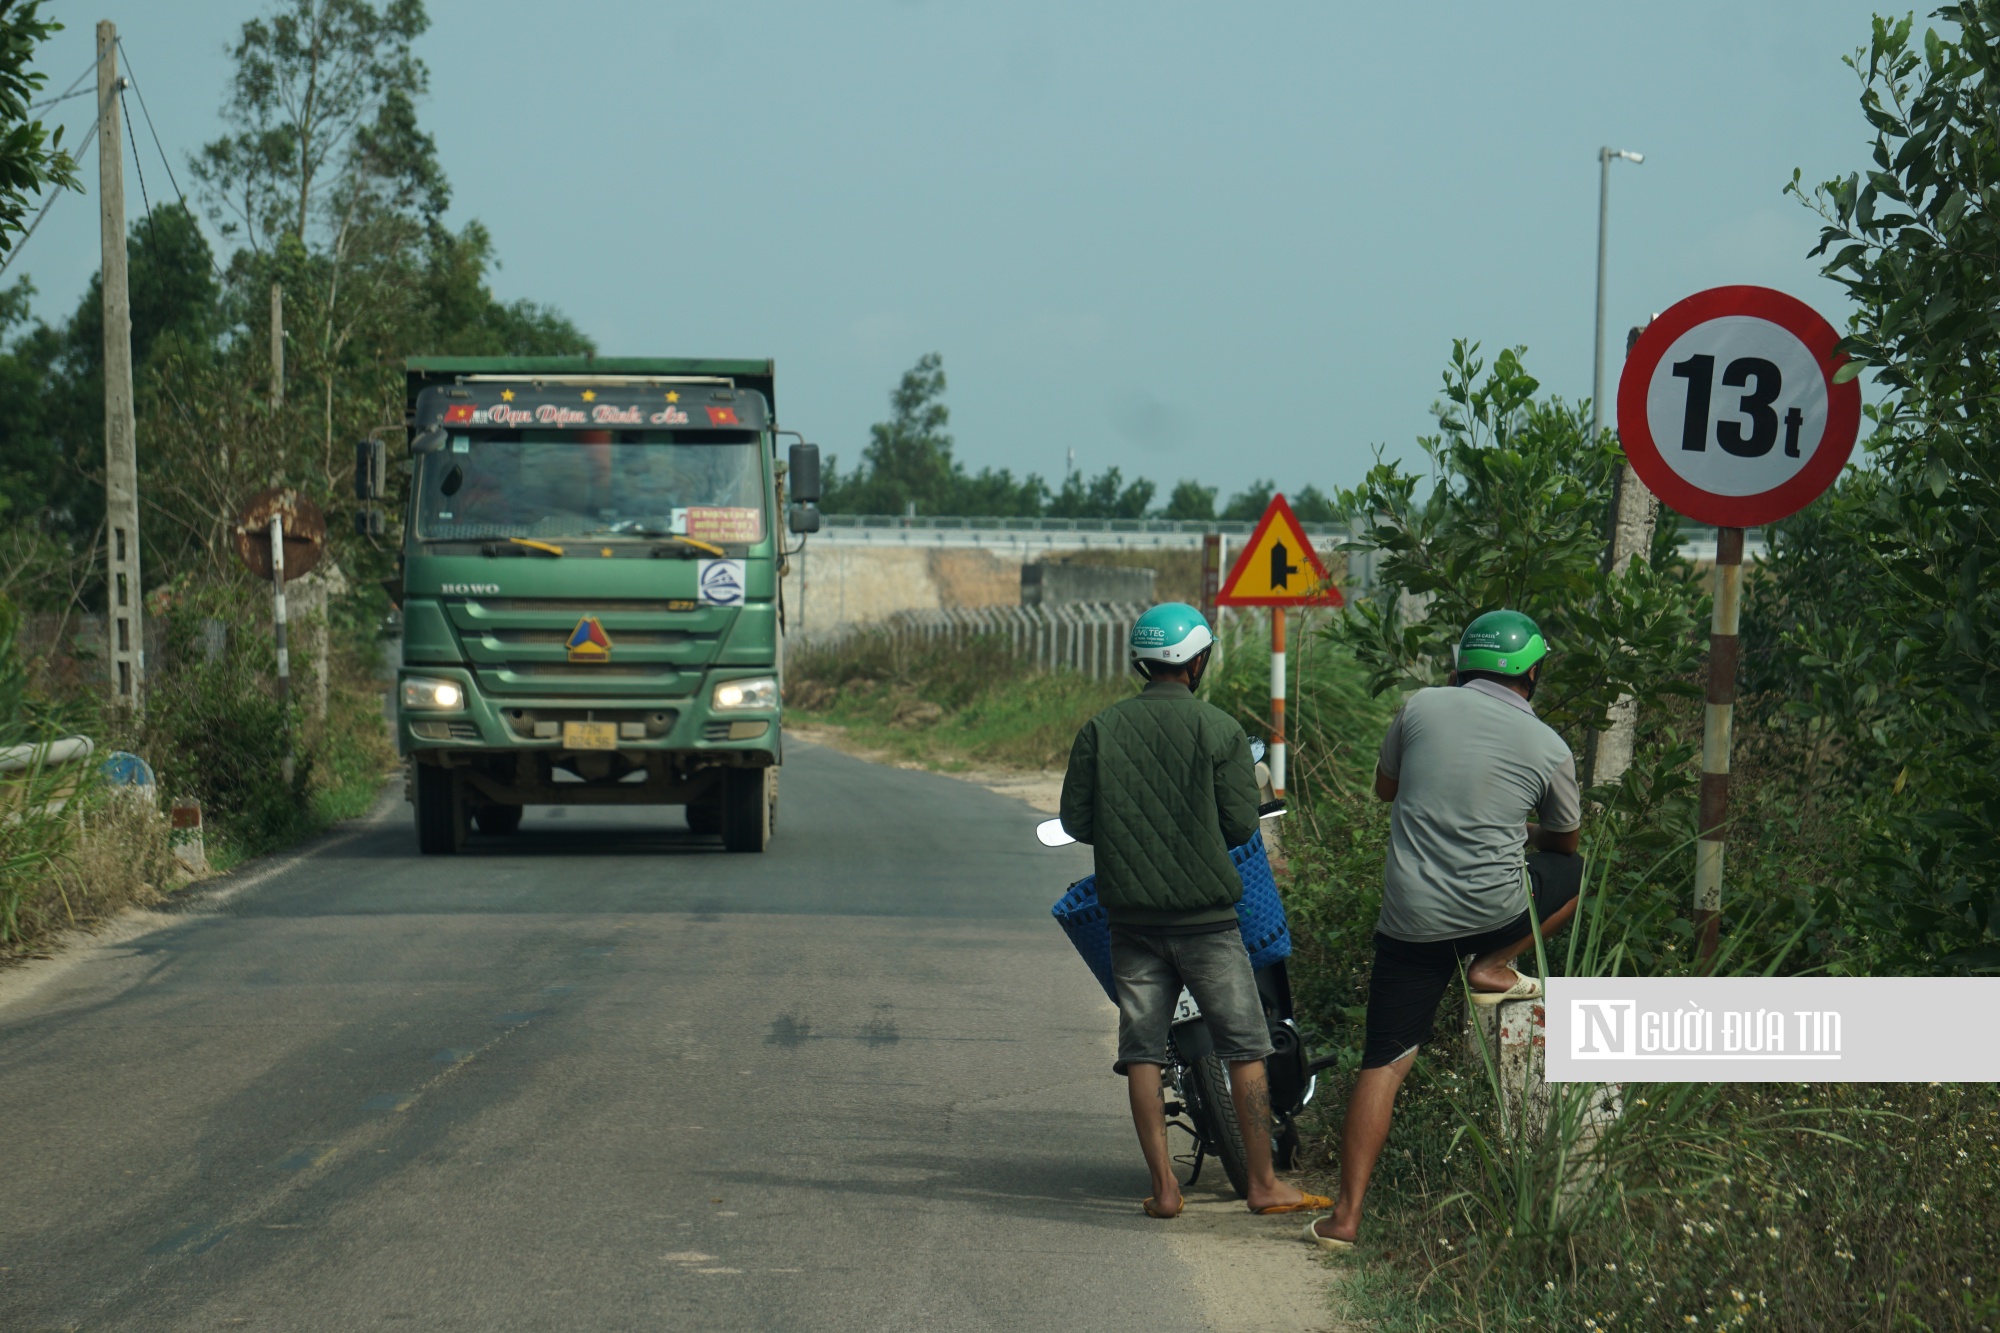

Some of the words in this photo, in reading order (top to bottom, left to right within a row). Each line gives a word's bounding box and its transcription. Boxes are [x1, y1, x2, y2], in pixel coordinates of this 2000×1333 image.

[650, 405, 689, 424] An
[1672, 354, 1803, 458] 13t
[441, 583, 500, 594] HOWO
